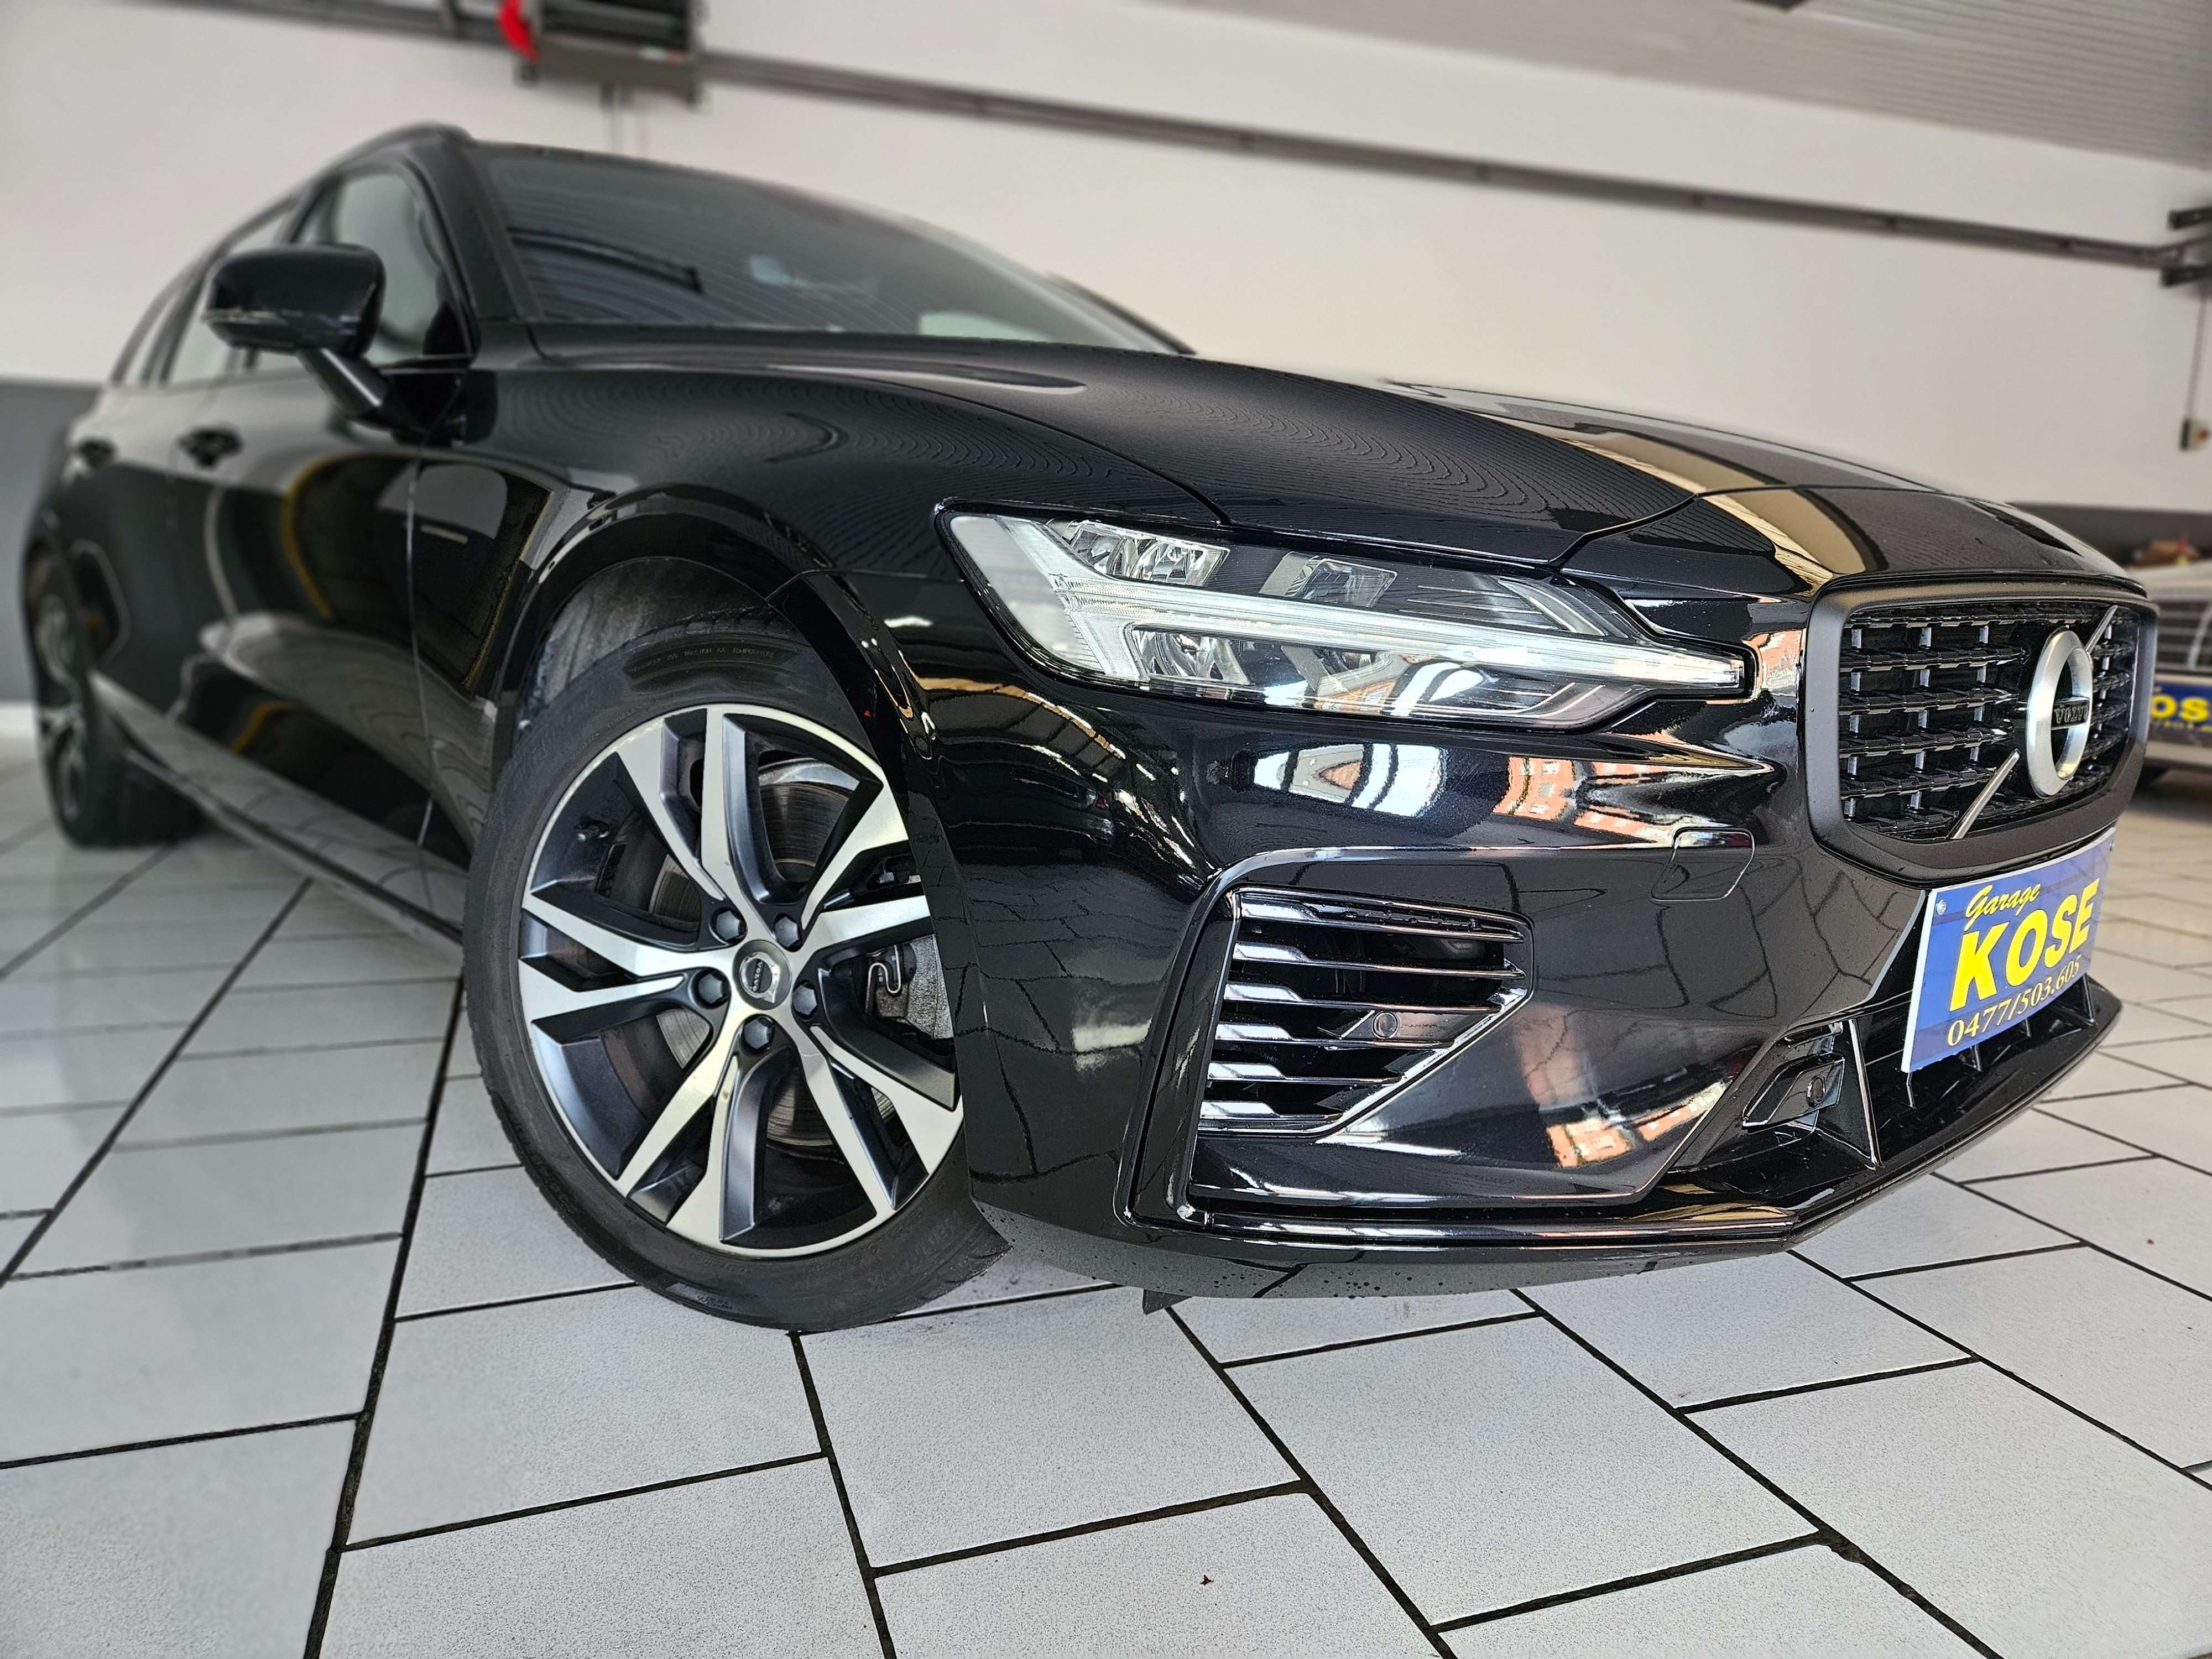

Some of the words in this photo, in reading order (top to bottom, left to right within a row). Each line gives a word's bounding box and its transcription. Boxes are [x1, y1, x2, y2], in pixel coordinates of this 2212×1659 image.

[2054, 704, 2088, 724] VOLVO
[1964, 883, 2041, 932] Garage
[1949, 878, 2100, 1013] KOSE
[753, 961, 763, 992] VOLVO
[1947, 953, 2080, 1047] 0477/503.605
